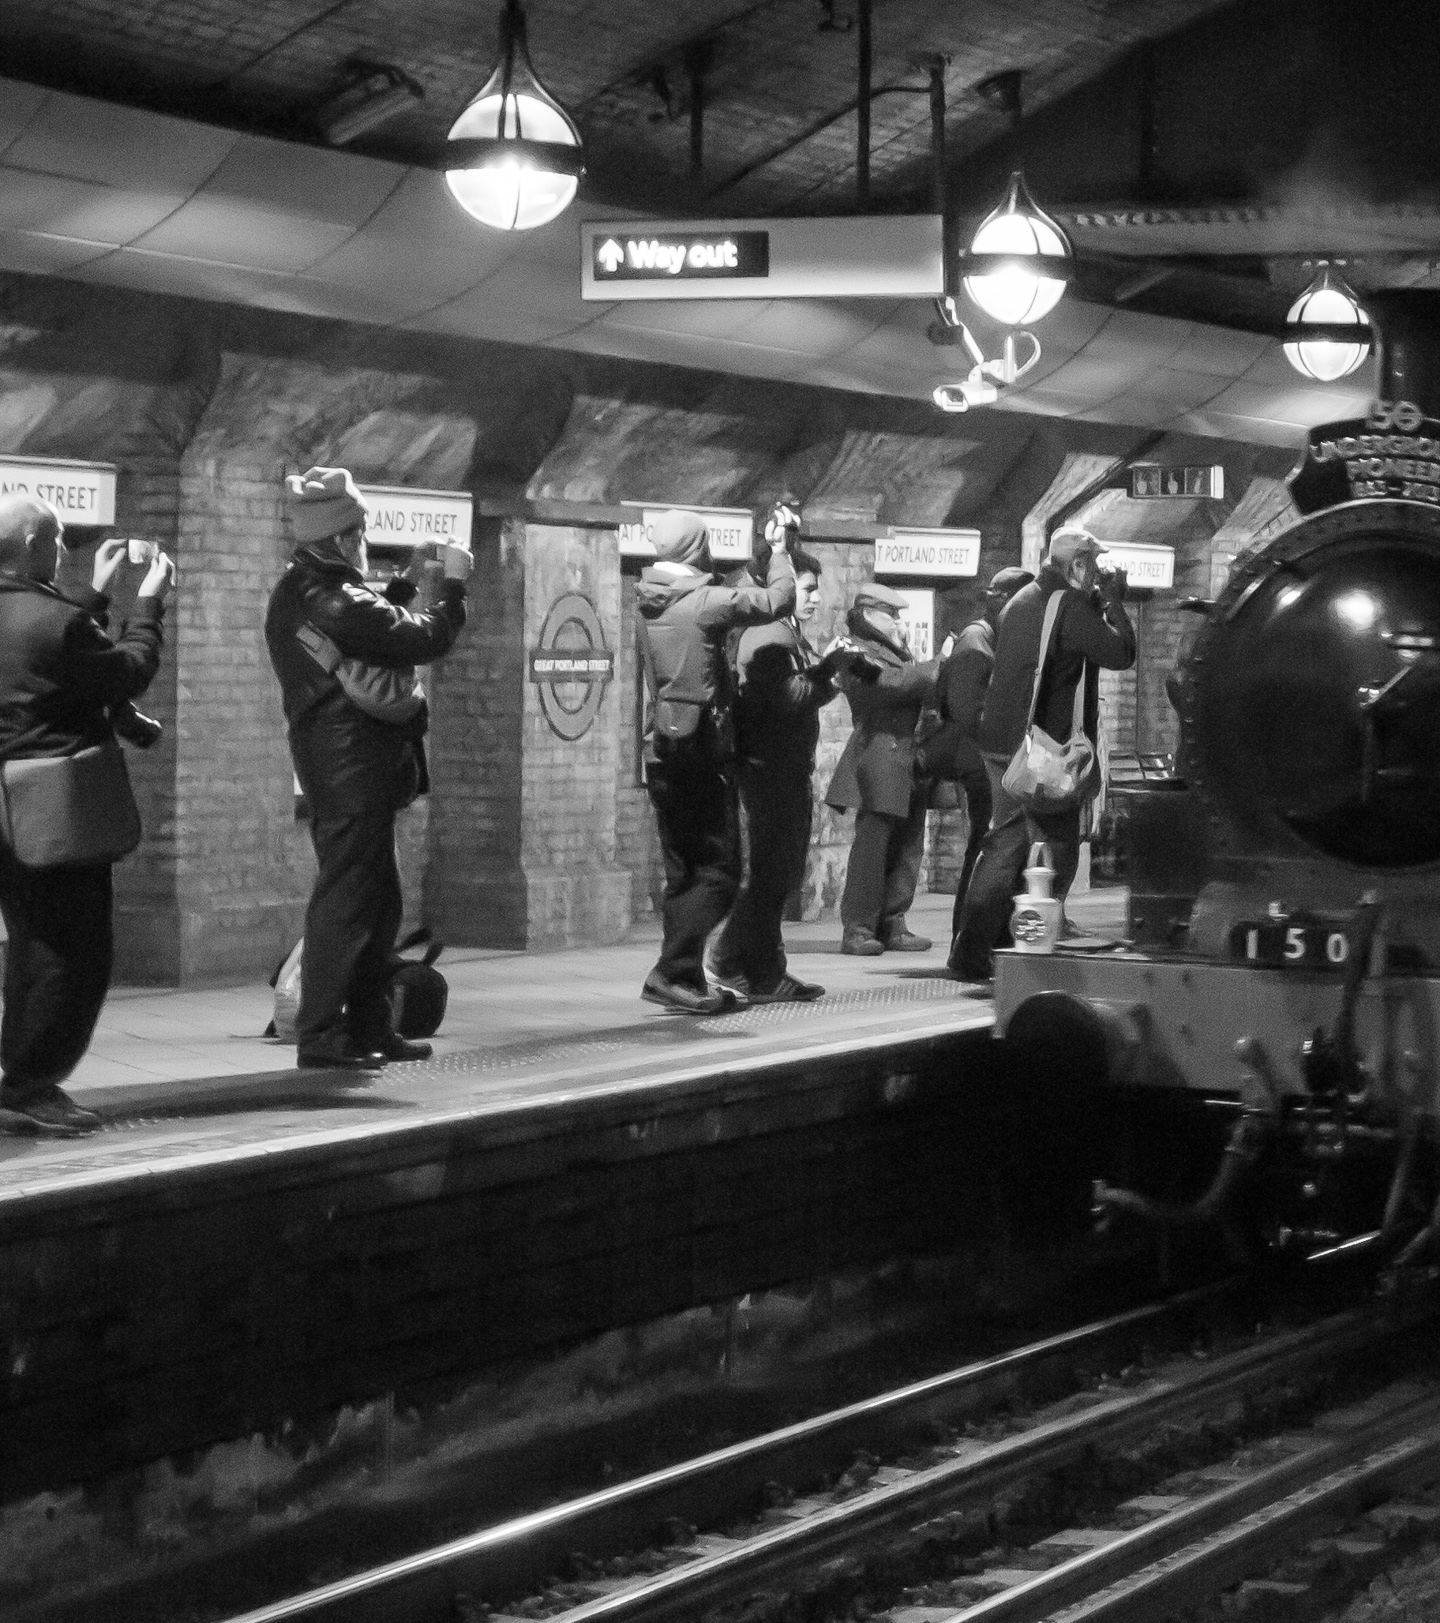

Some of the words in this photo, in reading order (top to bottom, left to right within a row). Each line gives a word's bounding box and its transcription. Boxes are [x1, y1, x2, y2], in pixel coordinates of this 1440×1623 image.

[627, 240, 687, 274] Way
[688, 240, 738, 268] out
[36, 484, 98, 509] STREET
[410, 511, 458, 534] STREET
[709, 528, 742, 547] TREET
[885, 545, 936, 563] PORTLAND
[938, 547, 970, 565] STREET
[1138, 561, 1166, 578] STREET
[1246, 928, 1349, 962] 150
